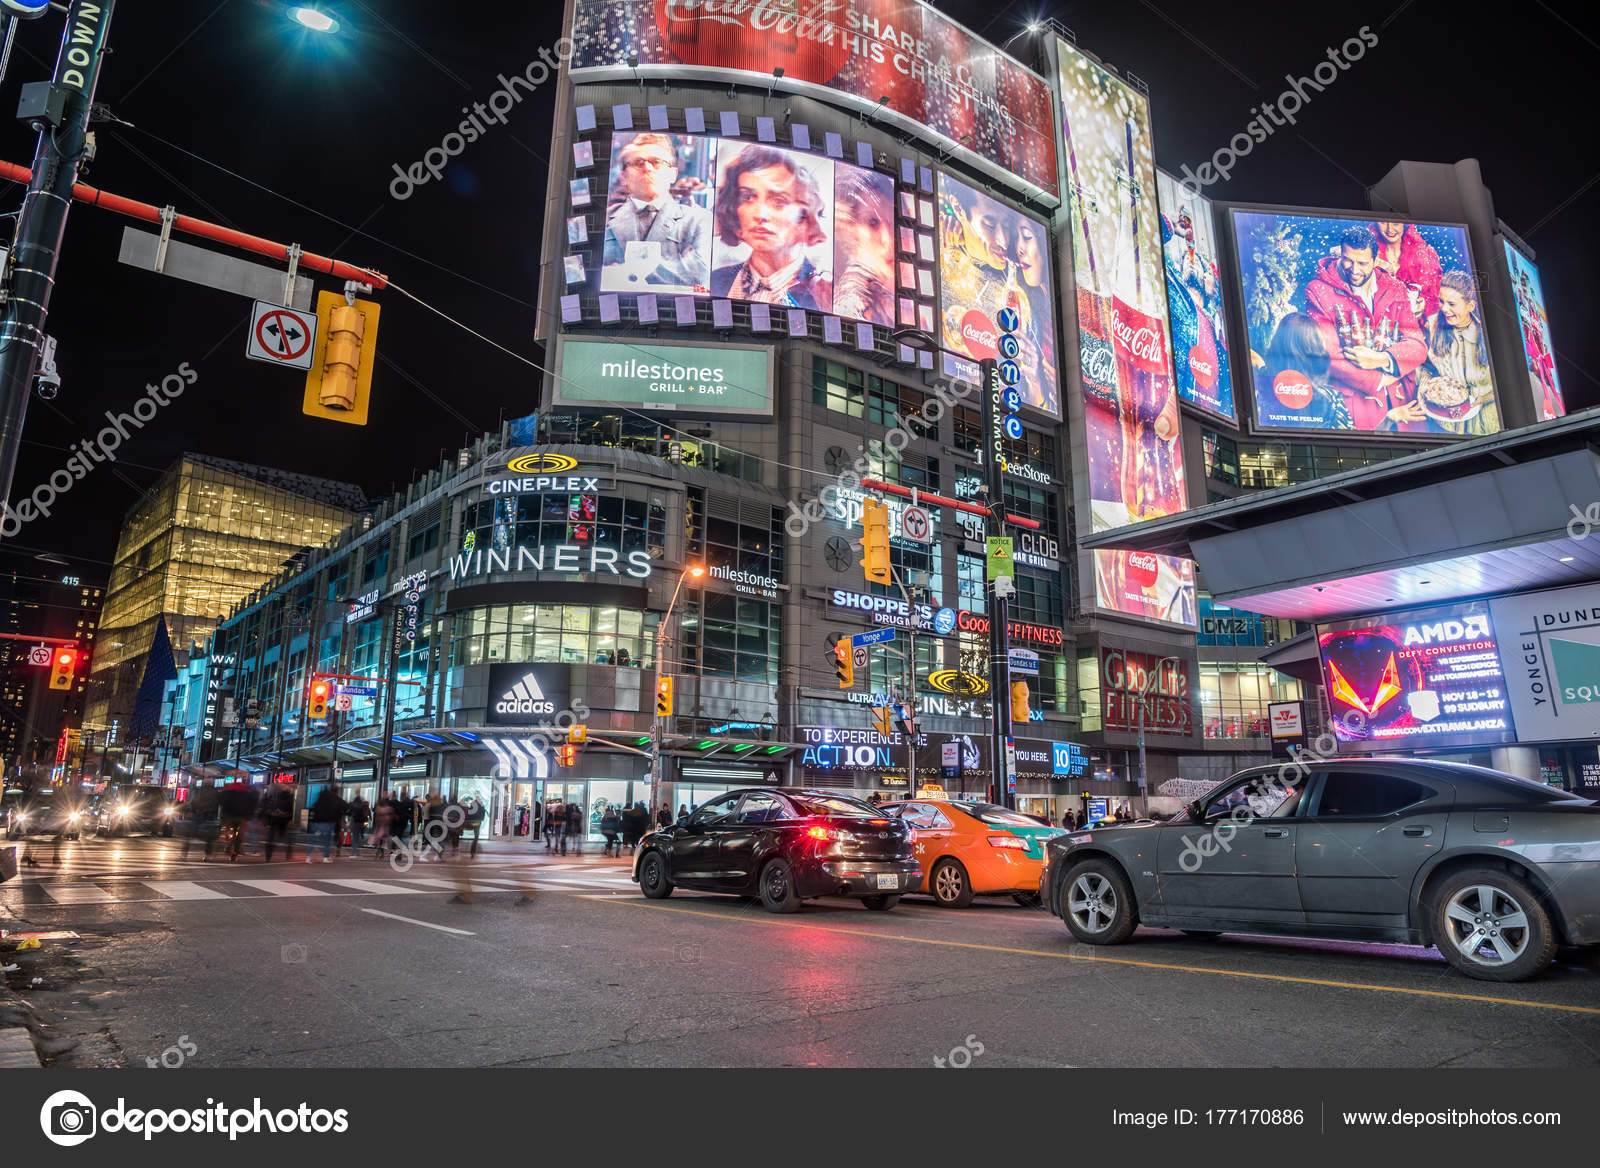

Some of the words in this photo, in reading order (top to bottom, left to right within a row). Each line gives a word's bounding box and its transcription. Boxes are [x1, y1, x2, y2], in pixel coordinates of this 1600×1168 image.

[845, 8, 929, 59] SHARE
[963, 324, 996, 348] Coca-Cola
[602, 359, 724, 382] milestones
[650, 383, 685, 393] GRILL
[1275, 383, 1309, 396] Coca-Cola
[991, 367, 1003, 463] DOWNTOWN
[489, 477, 598, 494] CINEPLEX
[450, 545, 651, 580] WINNERS
[1129, 552, 1156, 572] Coca-Cola
[62, 575, 80, 586] 415
[709, 564, 778, 589] milestones
[736, 584, 757, 595] GRILL
[763, 588, 777, 598] BAR
[875, 613, 905, 627] DRUG
[905, 616, 933, 630] MRT
[1204, 618, 1248, 635] DMZ
[862, 633, 881, 645] Yonge
[1013, 623, 1063, 646] FITNESS
[1404, 621, 1465, 646] AMD
[1399, 650, 1422, 659] DEFY
[1425, 641, 1496, 656] CONVENTION.
[1522, 641, 1547, 707] YONGE
[203, 655, 224, 740] WINNERS
[1442, 692, 1464, 702] NOV
[496, 699, 555, 714] adidas
[803, 728, 821, 743] TO
[824, 729, 902, 745] EXPERIENCE
[1016, 750, 1030, 761] YOU
[1056, 748, 1069, 768] 10
